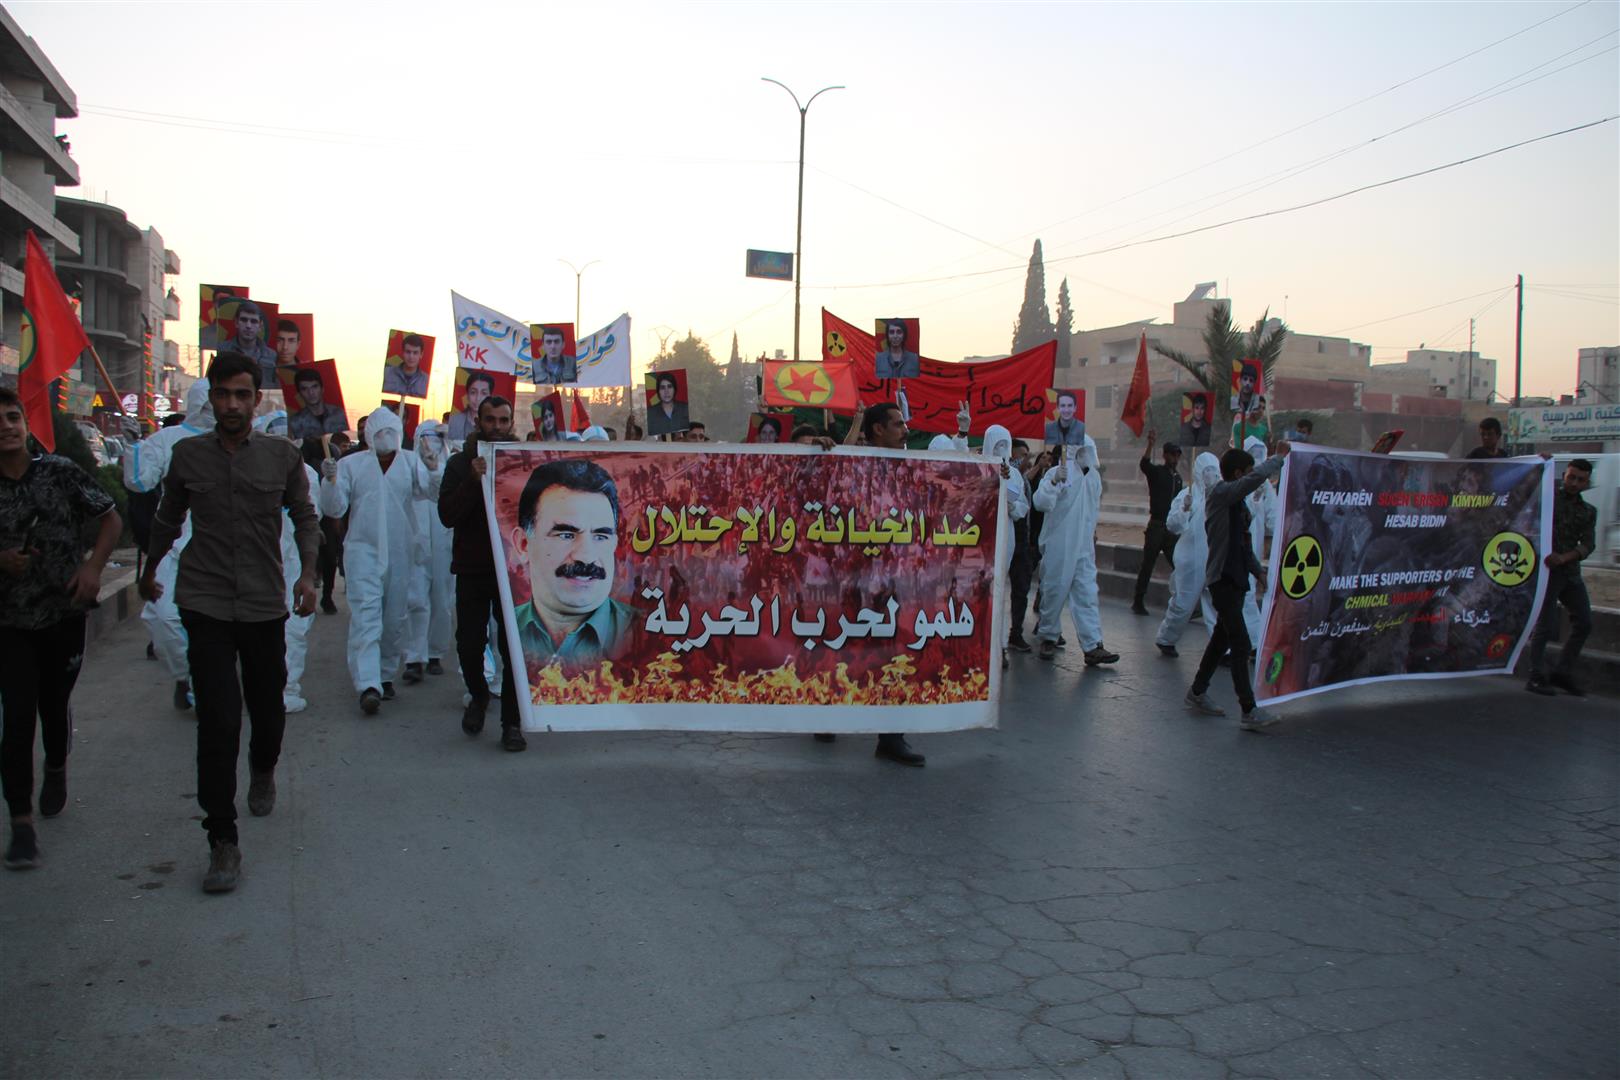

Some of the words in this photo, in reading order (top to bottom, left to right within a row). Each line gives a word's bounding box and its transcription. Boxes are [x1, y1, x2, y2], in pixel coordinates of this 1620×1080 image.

[1311, 489, 1373, 506] HEVKARÊN
[631, 504, 797, 554] والإحتلال
[803, 501, 927, 555] الخيانة
[932, 512, 982, 547] ضد
[1384, 514, 1418, 528] HESAB
[1419, 514, 1447, 528] BIDIN
[1328, 575, 1359, 590] MAKE
[1360, 573, 1379, 588] THE
[1380, 569, 1442, 586] SUPPORTERS
[1344, 594, 1389, 609] CHMICAL
[641, 585, 781, 653] الحرية
[791, 595, 900, 650] لحرب
[906, 595, 976, 650] هلمو
[1300, 620, 1330, 641] الثمن
[1454, 608, 1491, 628] شركاء
